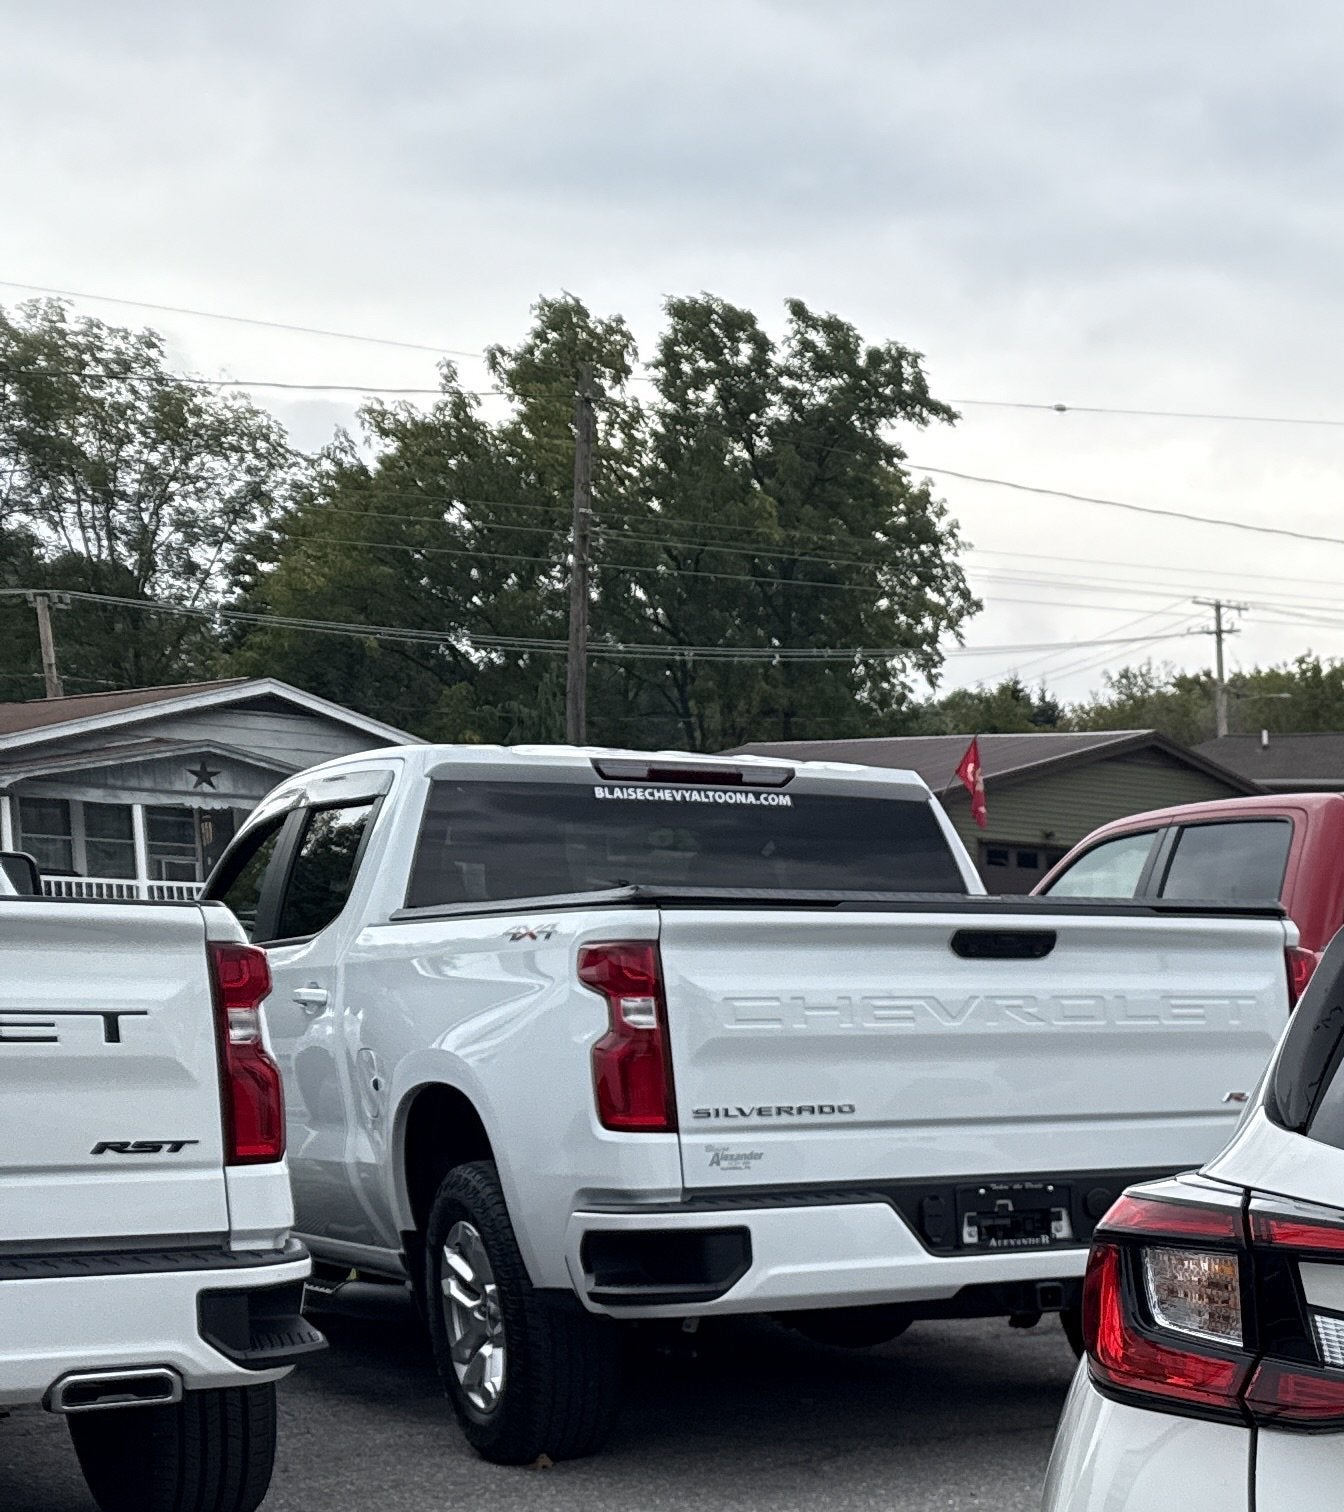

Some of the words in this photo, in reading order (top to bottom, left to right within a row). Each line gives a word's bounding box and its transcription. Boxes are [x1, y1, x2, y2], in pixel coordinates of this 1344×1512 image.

[593, 786, 794, 807] BLAISECHEVYALTOONA.COM
[722, 994, 1258, 1030] CHEVROLET
[692, 1104, 856, 1119] SILVERADO
[90, 1140, 199, 1155] RST
